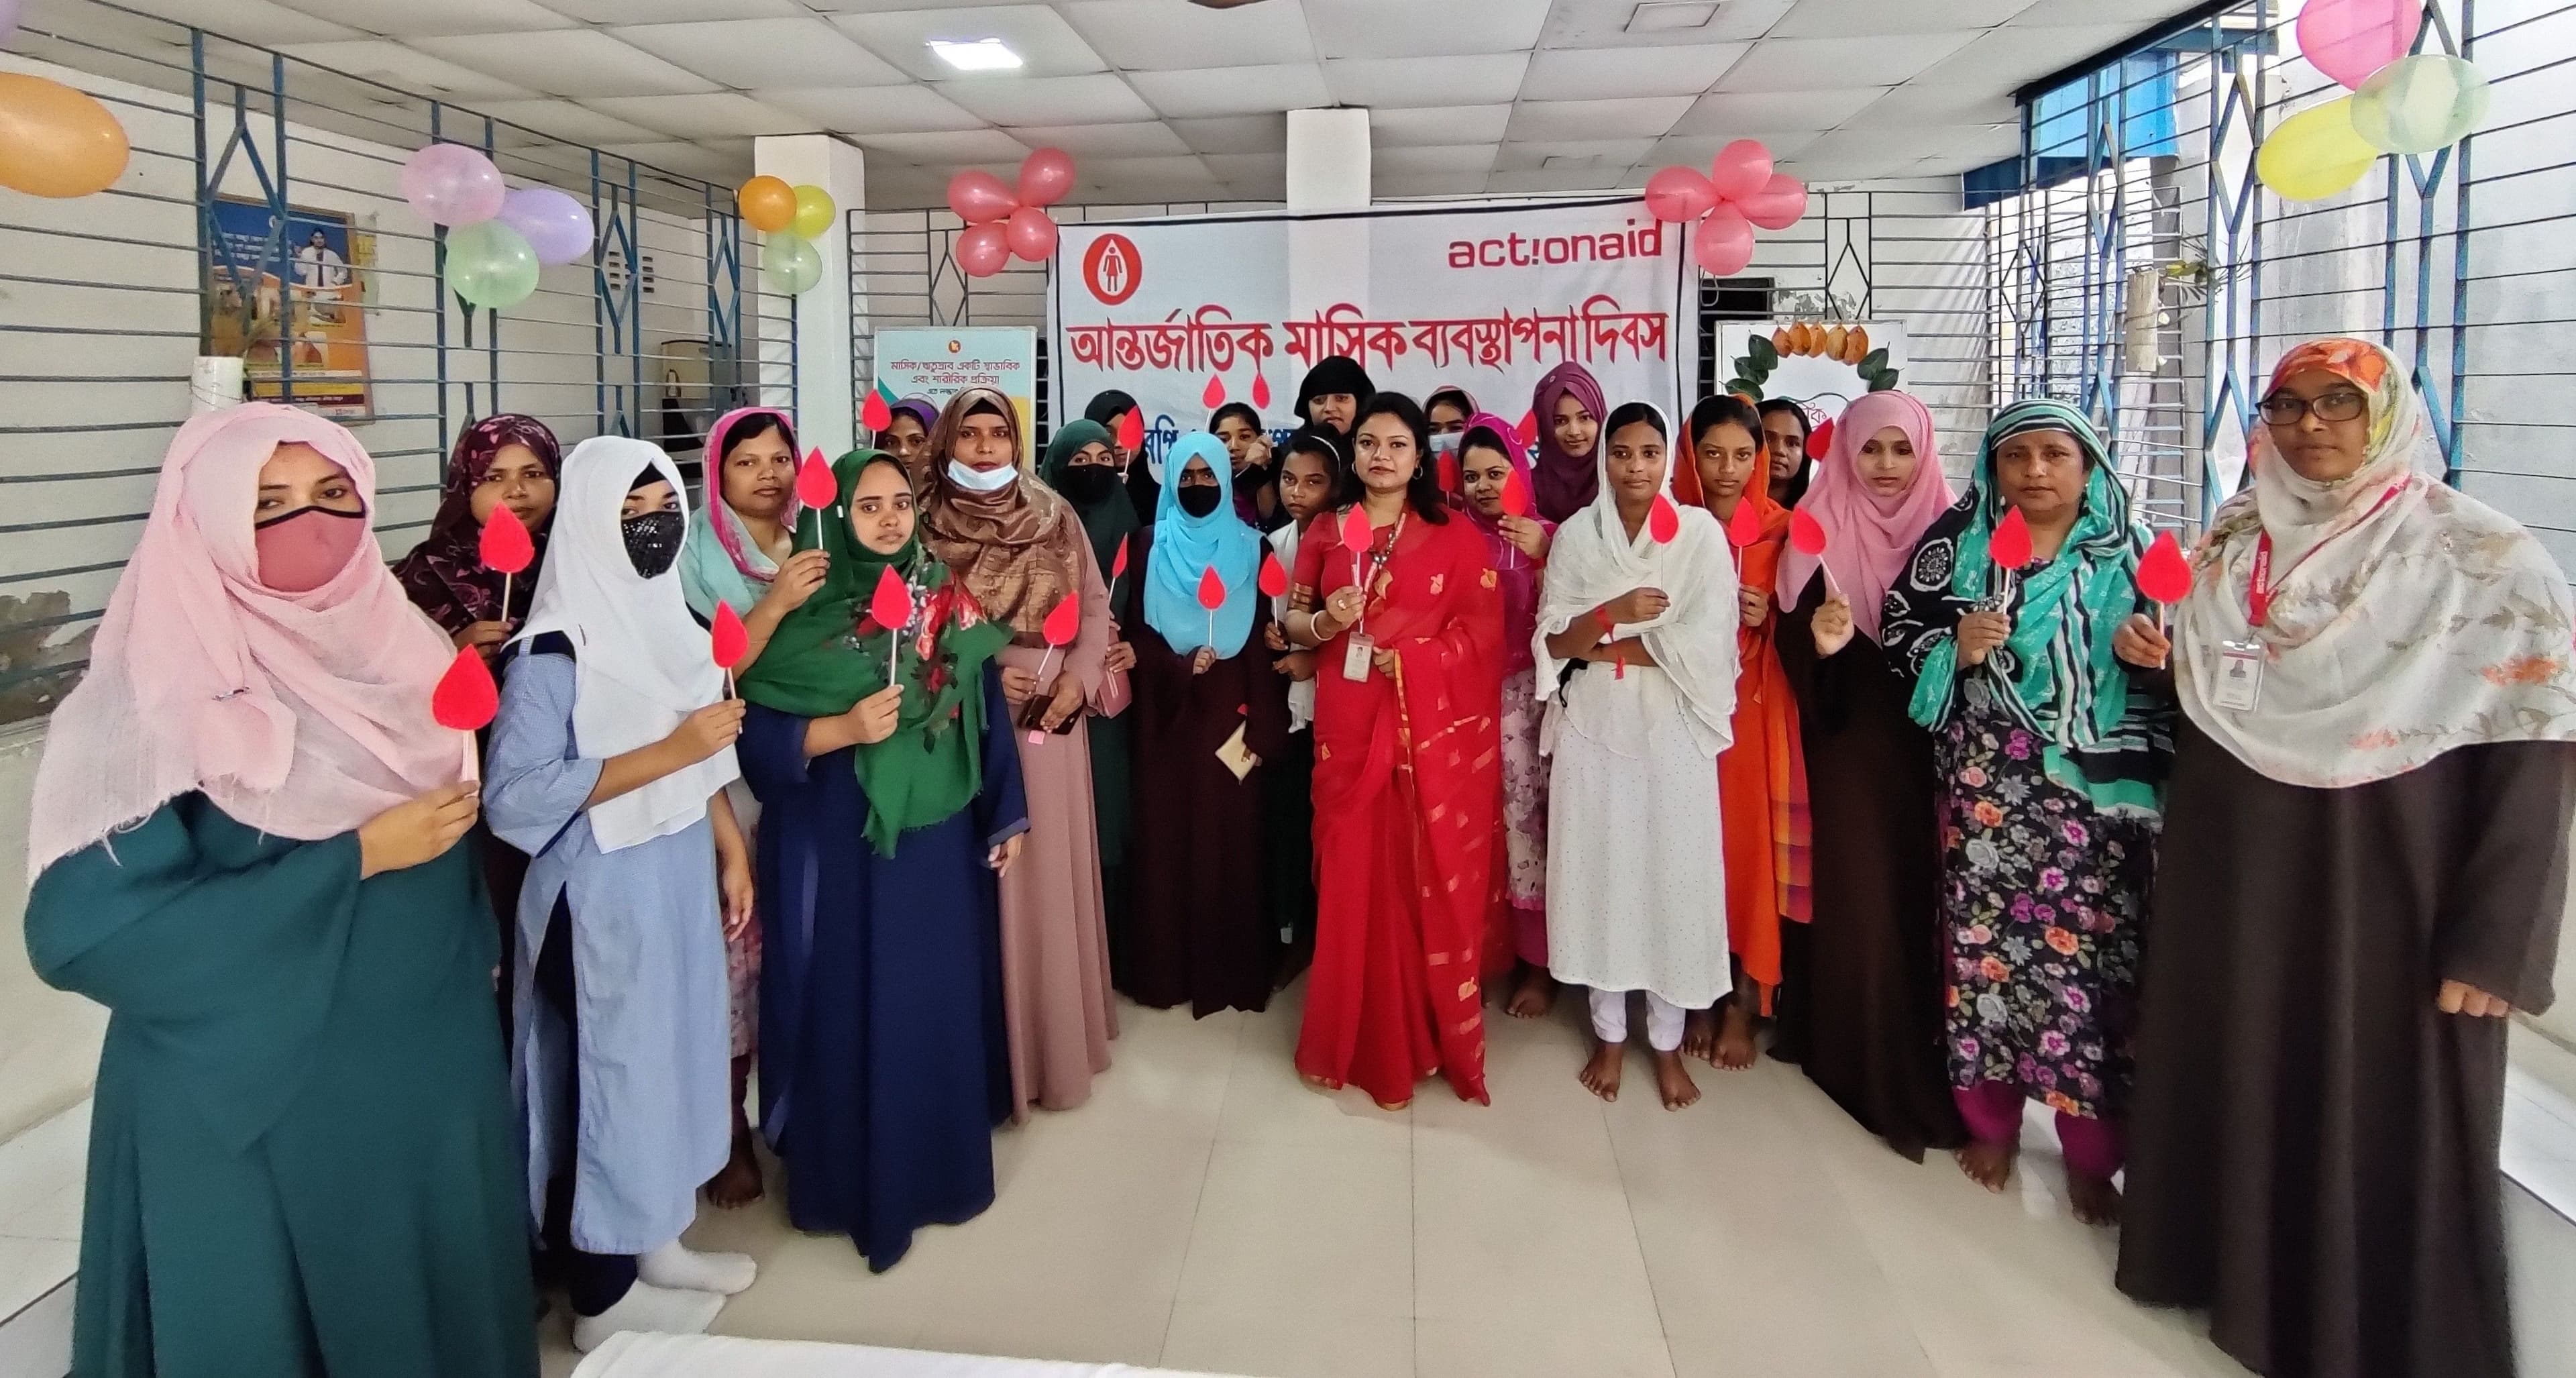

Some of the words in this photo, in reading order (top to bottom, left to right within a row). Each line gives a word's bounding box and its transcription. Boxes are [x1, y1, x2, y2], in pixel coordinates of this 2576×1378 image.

[1065, 303, 1275, 373] আন্তর্জাতিক
[1282, 302, 1407, 372] মাসিক
[1580, 294, 1670, 365] দিবস
[957, 358, 981, 370] একটি
[983, 358, 1020, 371] স্বাভাবিক
[911, 374, 929, 384] এবং
[932, 372, 968, 384] শারীরিক
